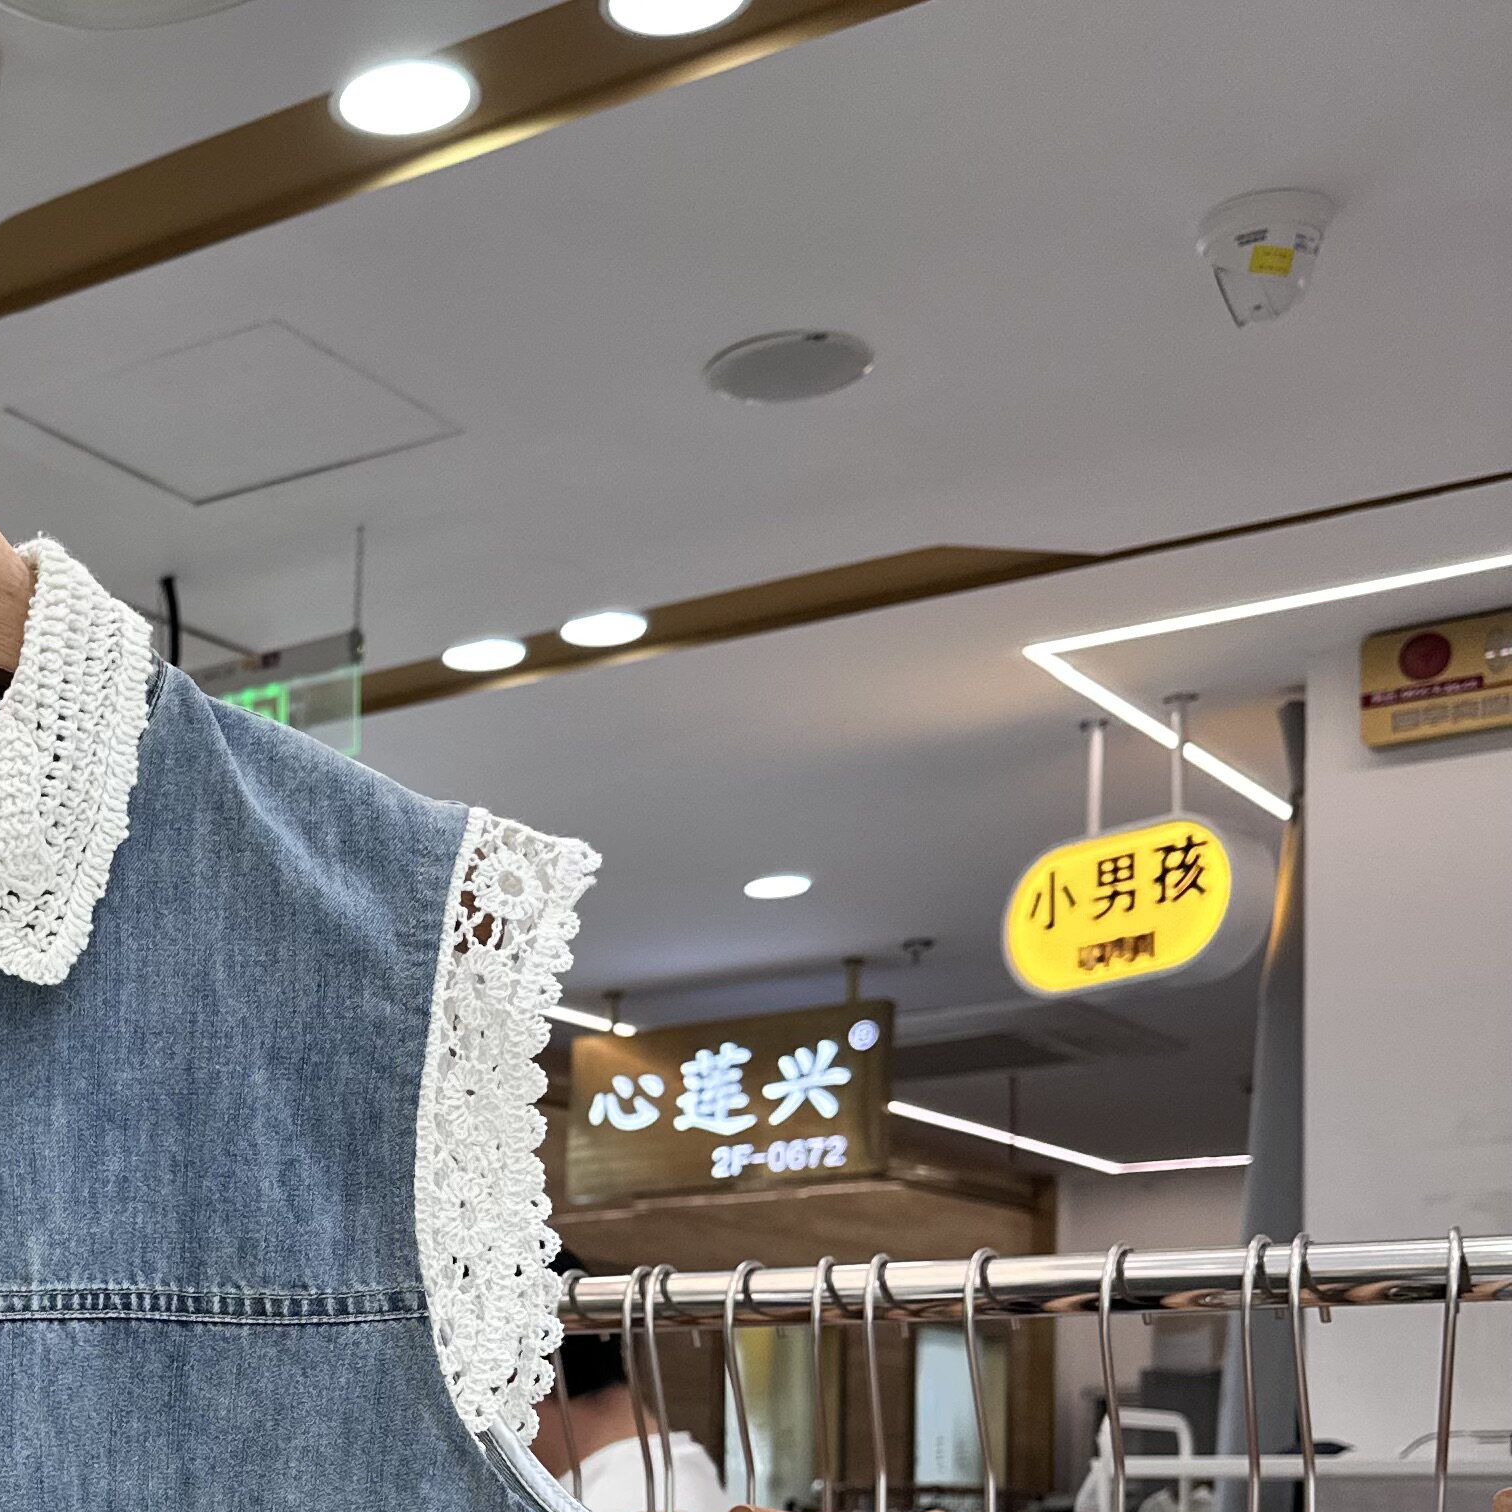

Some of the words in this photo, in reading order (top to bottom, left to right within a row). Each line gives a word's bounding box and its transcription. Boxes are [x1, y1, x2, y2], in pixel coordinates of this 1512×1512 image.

[1029, 834, 1209, 930] 小男孩
[711, 1135, 848, 1179] 2F-0672
